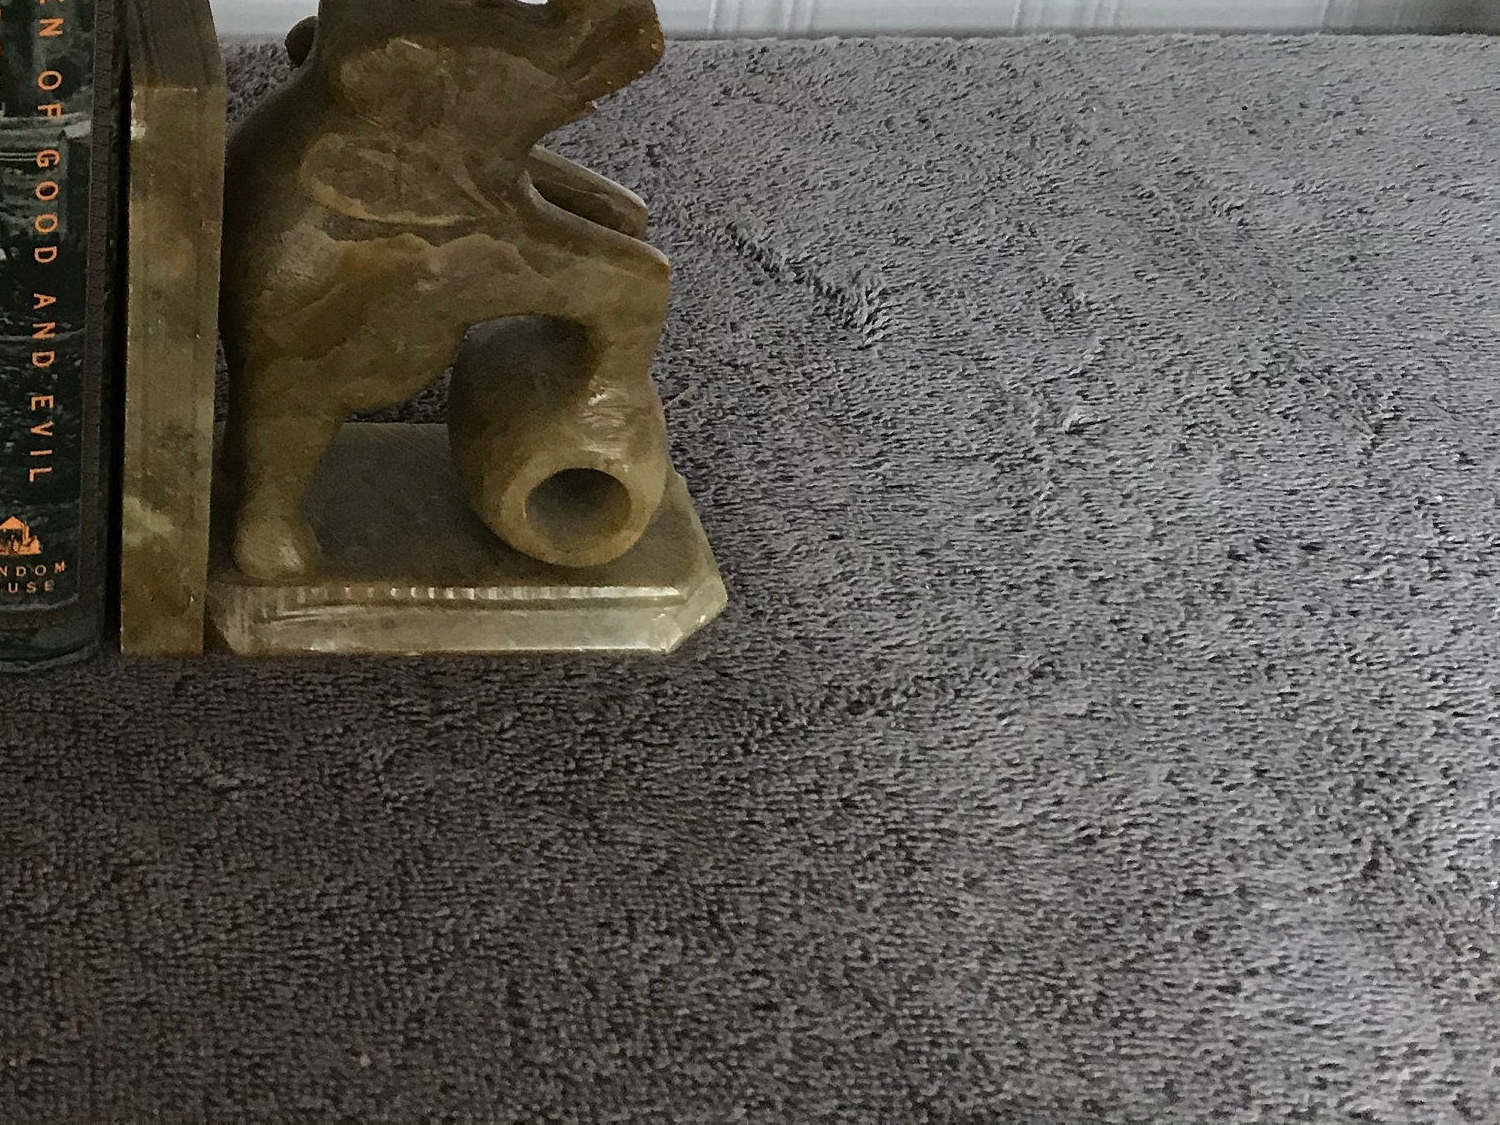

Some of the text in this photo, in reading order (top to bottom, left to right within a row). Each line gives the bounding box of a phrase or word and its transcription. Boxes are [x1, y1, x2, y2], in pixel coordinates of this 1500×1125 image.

[37, 70, 63, 120] OF
[34, 149, 61, 264] GOOD
[31, 293, 57, 368] AND
[29, 395, 54, 483] EVIL
